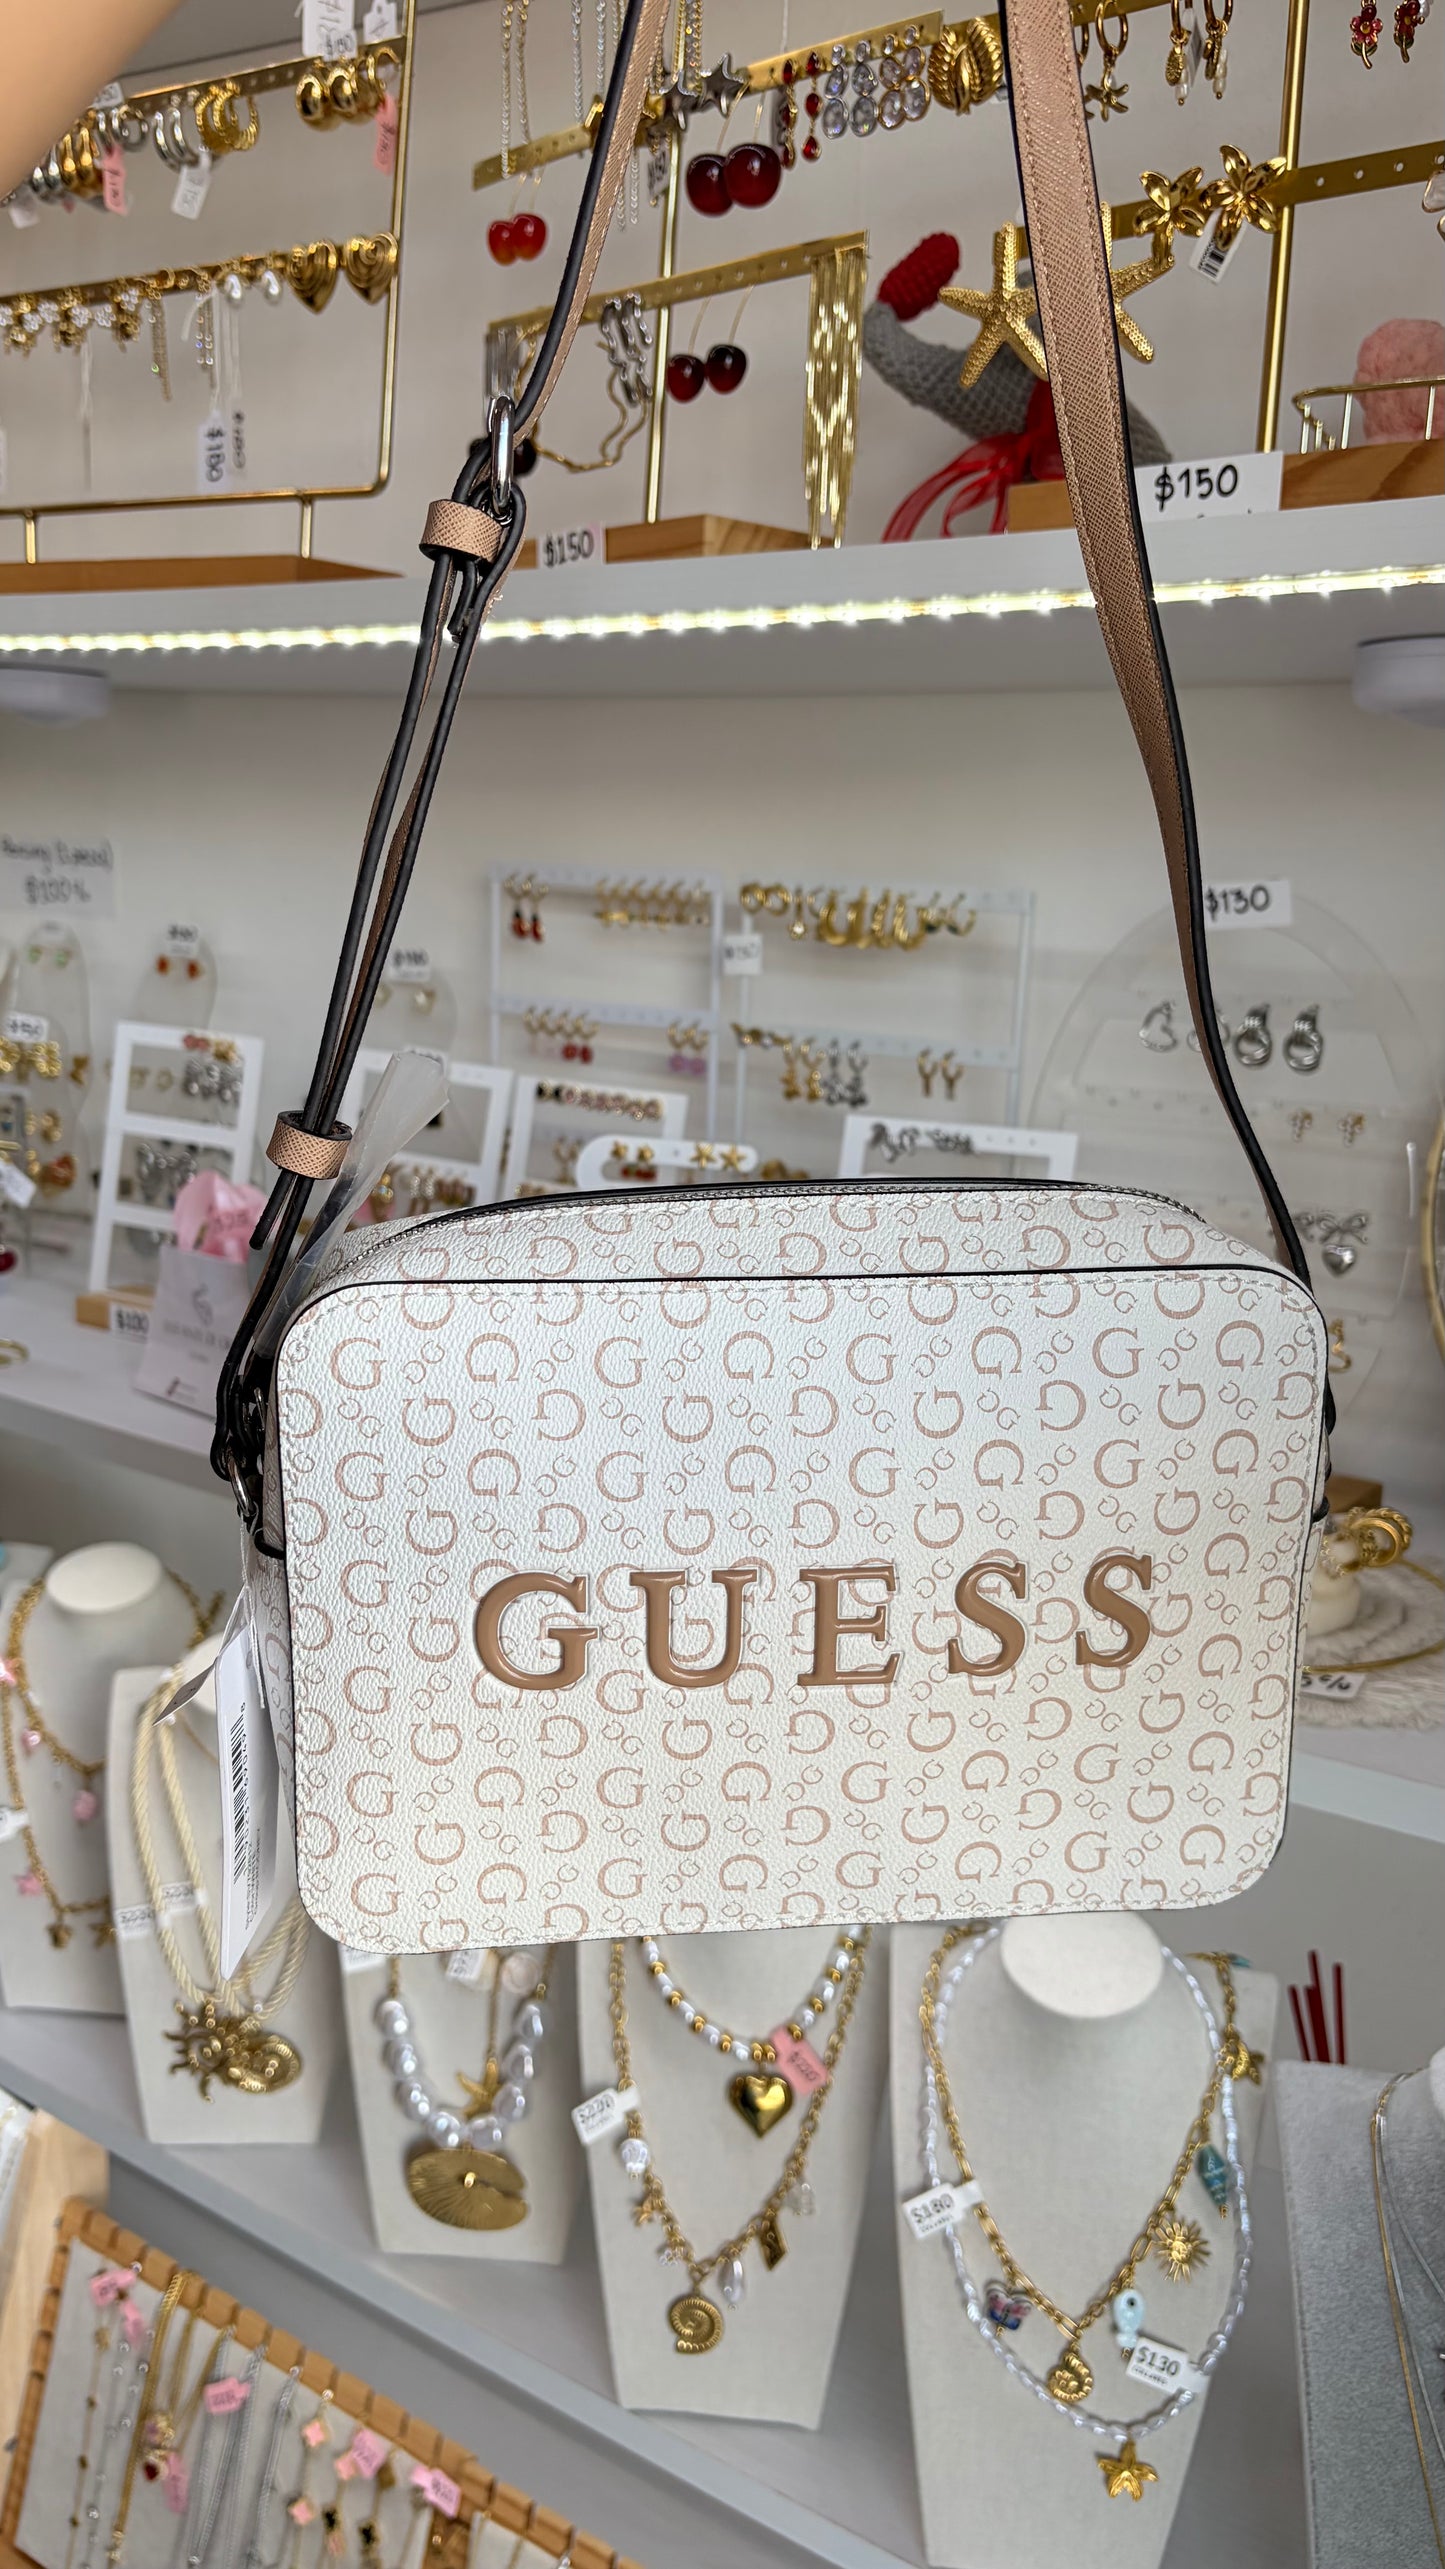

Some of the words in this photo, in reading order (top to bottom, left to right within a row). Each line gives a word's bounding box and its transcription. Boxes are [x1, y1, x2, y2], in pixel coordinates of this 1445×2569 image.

[1155, 466, 1238, 512] $150
[543, 530, 594, 568] $150
[1205, 884, 1270, 922] $130
[472, 1553, 1153, 1690] GUESS
[1136, 2345, 1181, 2377] $130
